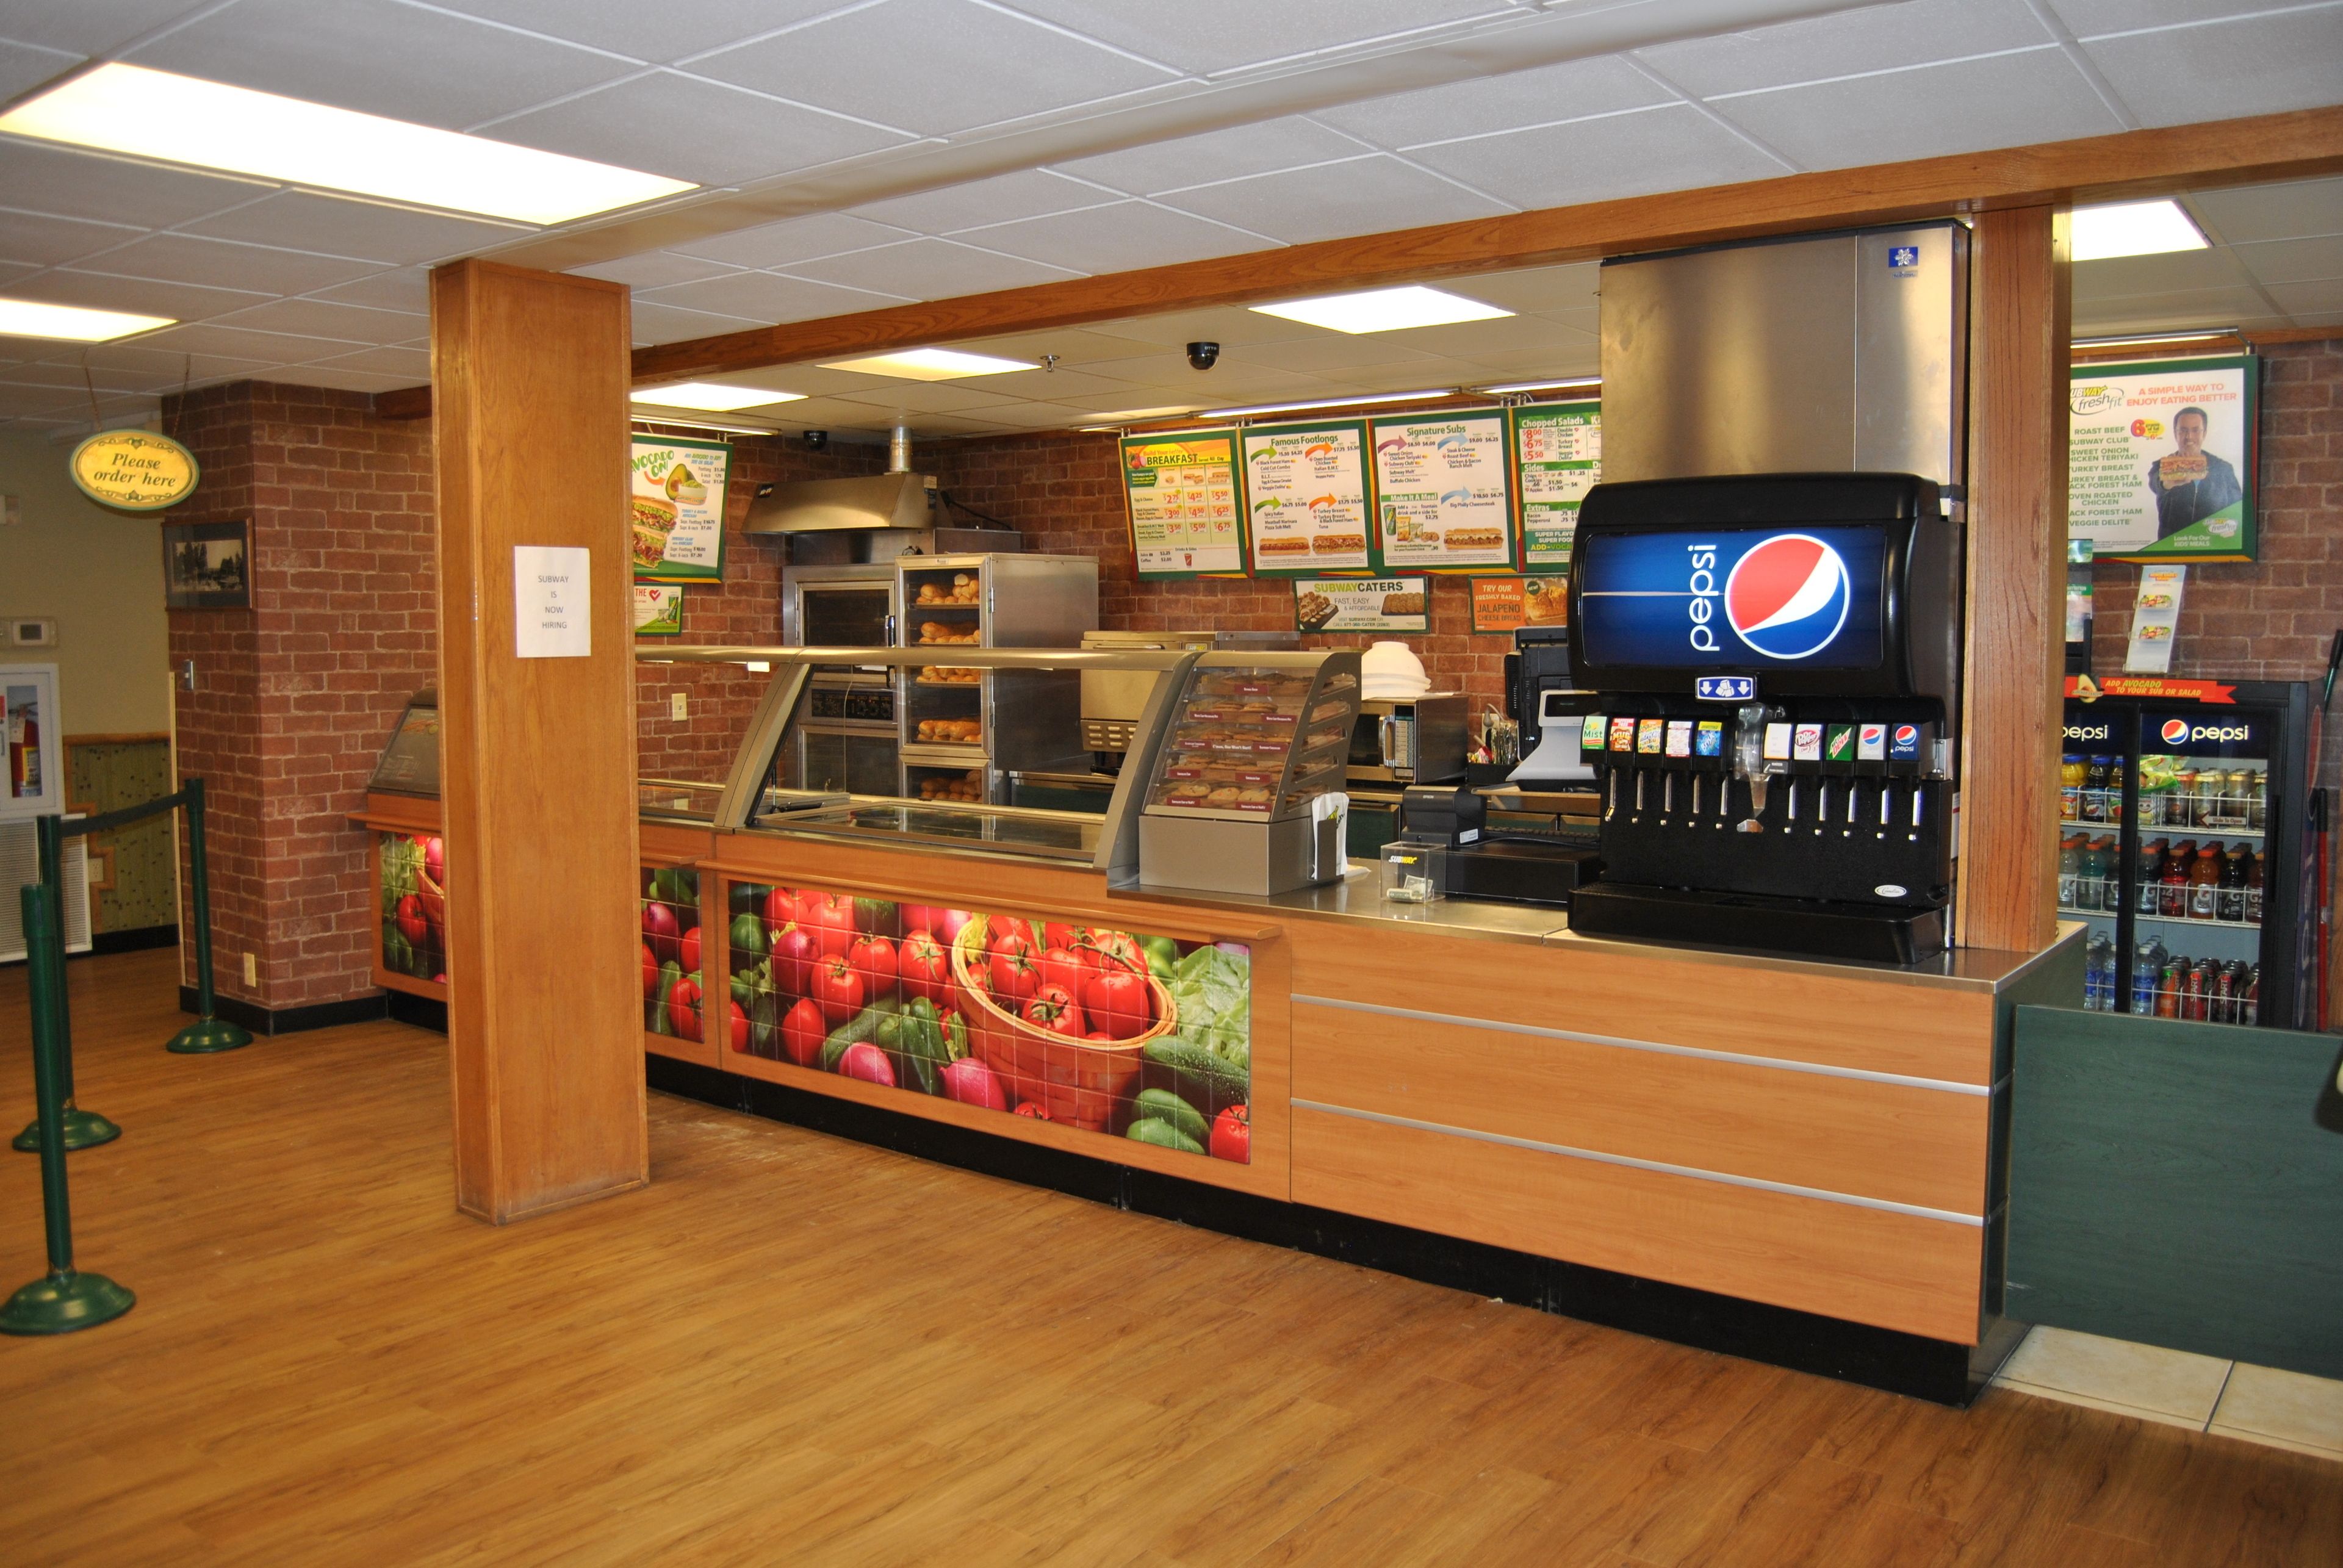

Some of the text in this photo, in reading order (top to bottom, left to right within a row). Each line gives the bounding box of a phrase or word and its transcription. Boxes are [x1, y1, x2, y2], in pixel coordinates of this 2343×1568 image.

[2070, 386, 2108, 397] UBWAY
[2148, 386, 2183, 395] SIMPLE
[2078, 394, 2122, 412] fresh fit
[2161, 395, 2196, 405] EATING
[2198, 392, 2237, 402] BETTER
[1522, 419, 1557, 428] Chopped
[1558, 417, 1583, 425] Salads
[2131, 419, 2145, 437] 6
[1407, 425, 1466, 437] Signature Subs
[1271, 435, 1338, 447] Famous Footlongs
[112, 453, 161, 469] Please
[1146, 453, 1198, 466] BREAKFAST
[94, 470, 176, 487] order here
[635, 588, 647, 597] THE
[1688, 545, 1720, 651] pepsi
[1477, 602, 1521, 613] JALAPEÑO
[1584, 730, 1603, 738] Mist
[1613, 732, 1631, 740] MUG
[2192, 725, 2248, 743] pepsi
[1389, 855, 1417, 865] SUBWAY
[2198, 889, 2209, 900] G
